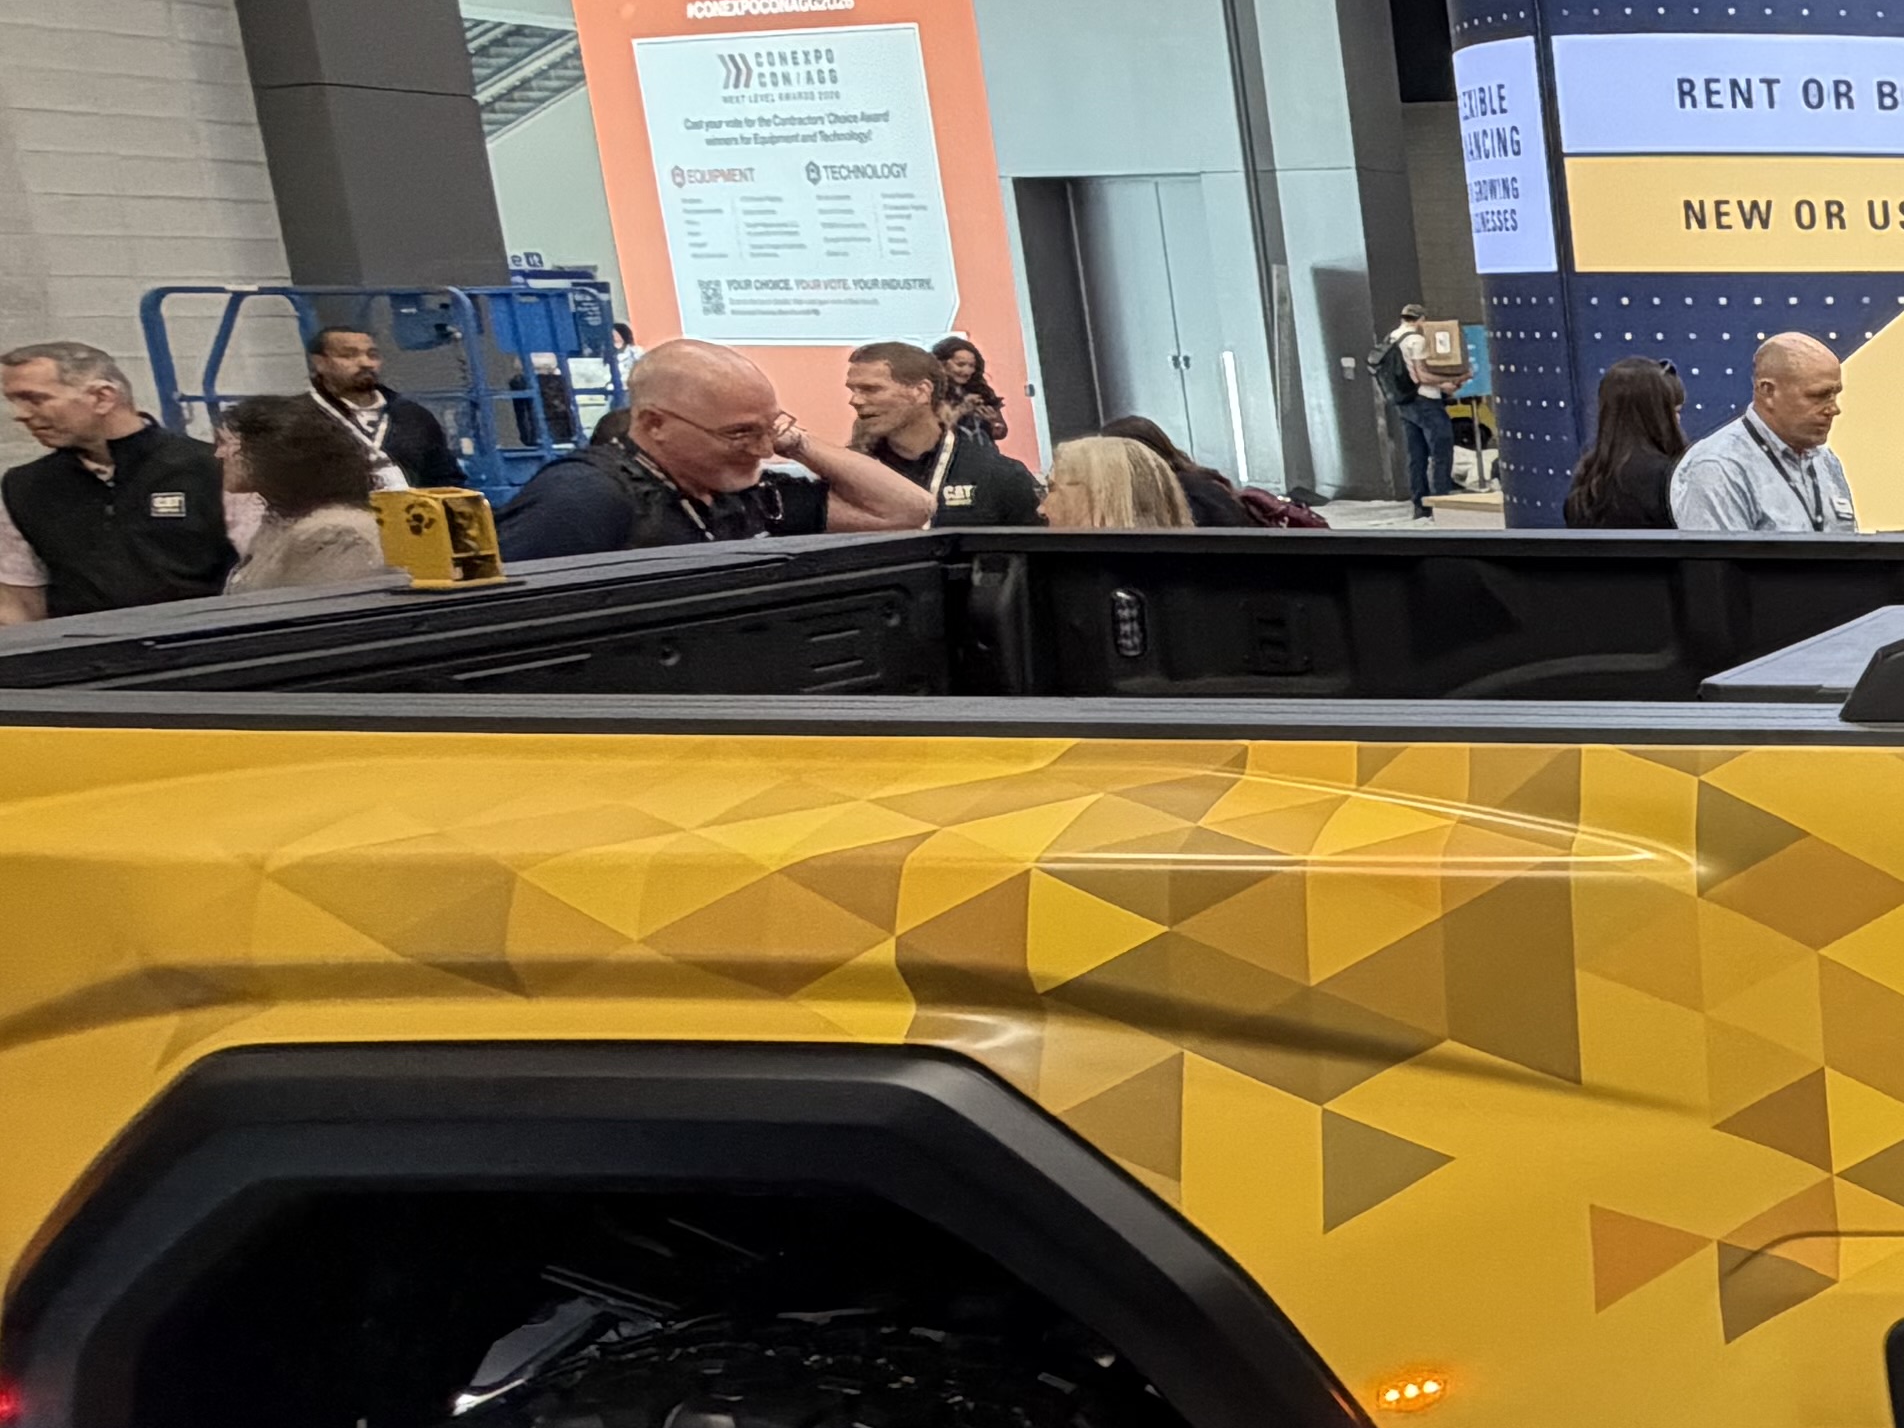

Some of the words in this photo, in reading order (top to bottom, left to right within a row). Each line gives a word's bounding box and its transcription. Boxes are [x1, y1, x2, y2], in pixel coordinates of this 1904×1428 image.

[754, 48, 836, 68] CONEXPO
[1676, 77, 1782, 110] RENT
[1801, 77, 1856, 111] OR
[686, 167, 756, 185] EQUIPMENT
[821, 162, 908, 182] TECHNOLOGY
[1682, 199, 1773, 231] NEW
[1794, 199, 1847, 231] OR
[943, 484, 976, 500] CAT
